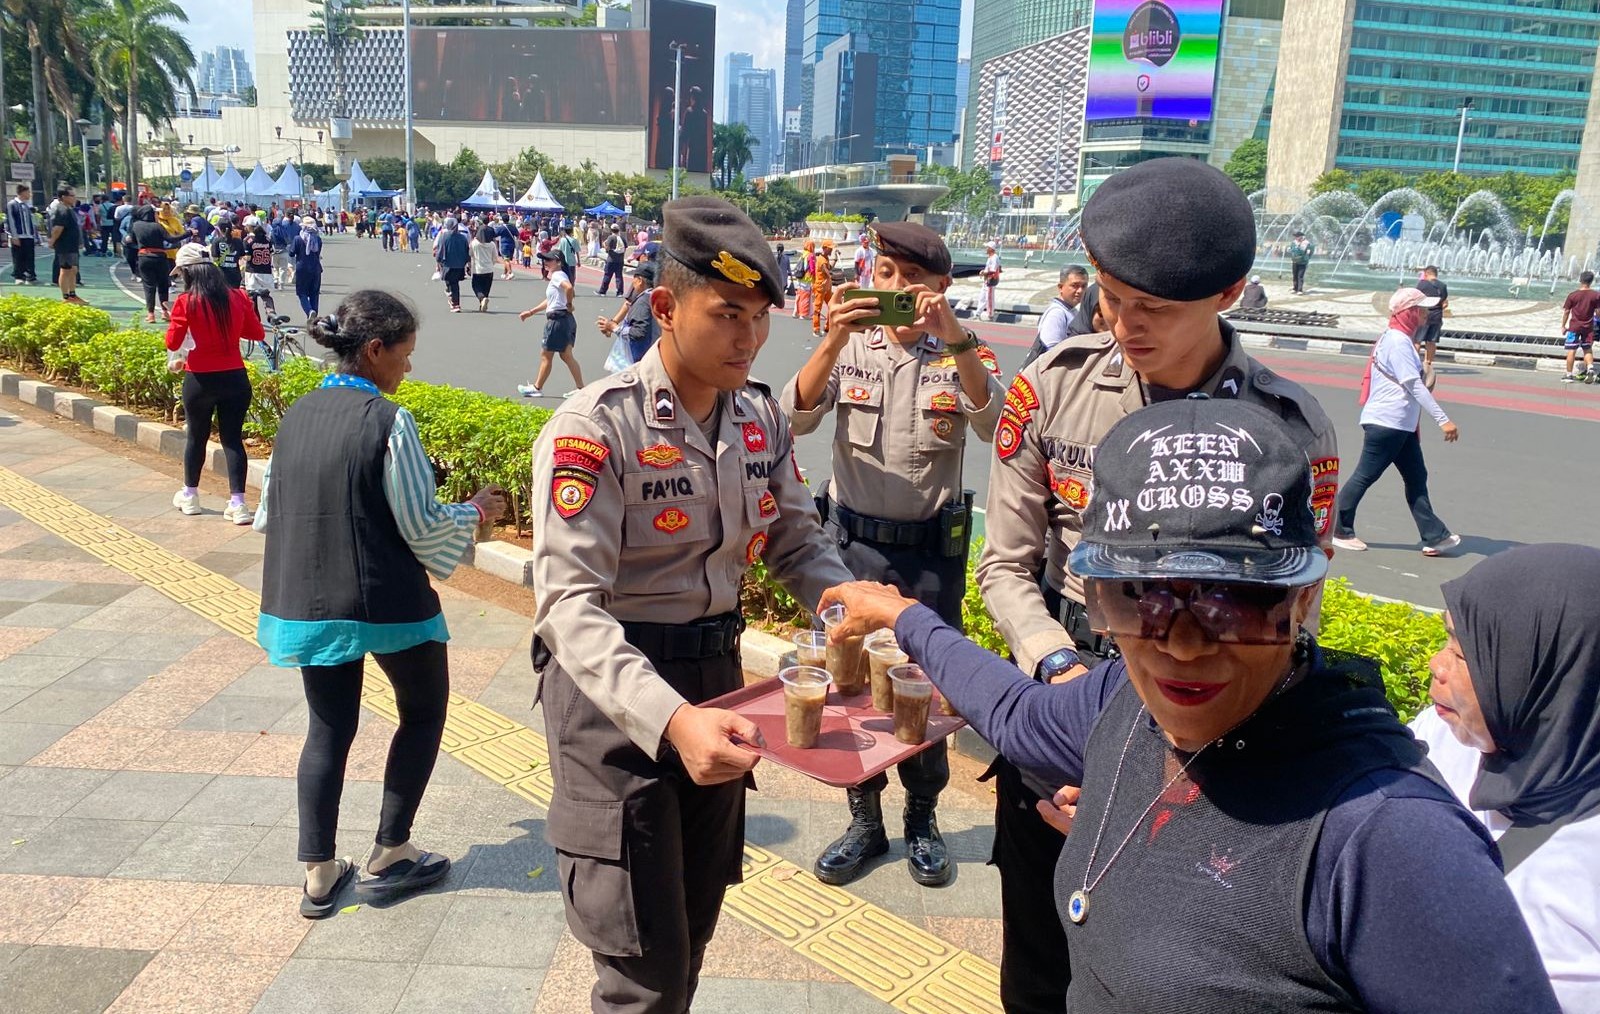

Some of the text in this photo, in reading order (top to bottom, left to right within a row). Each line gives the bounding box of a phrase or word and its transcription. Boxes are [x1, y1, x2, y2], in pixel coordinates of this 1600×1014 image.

[1140, 30, 1173, 46] blibli
[1150, 433, 1240, 458] KEEN
[642, 476, 693, 500] FA'IQ
[1136, 484, 1254, 513] CROSS
